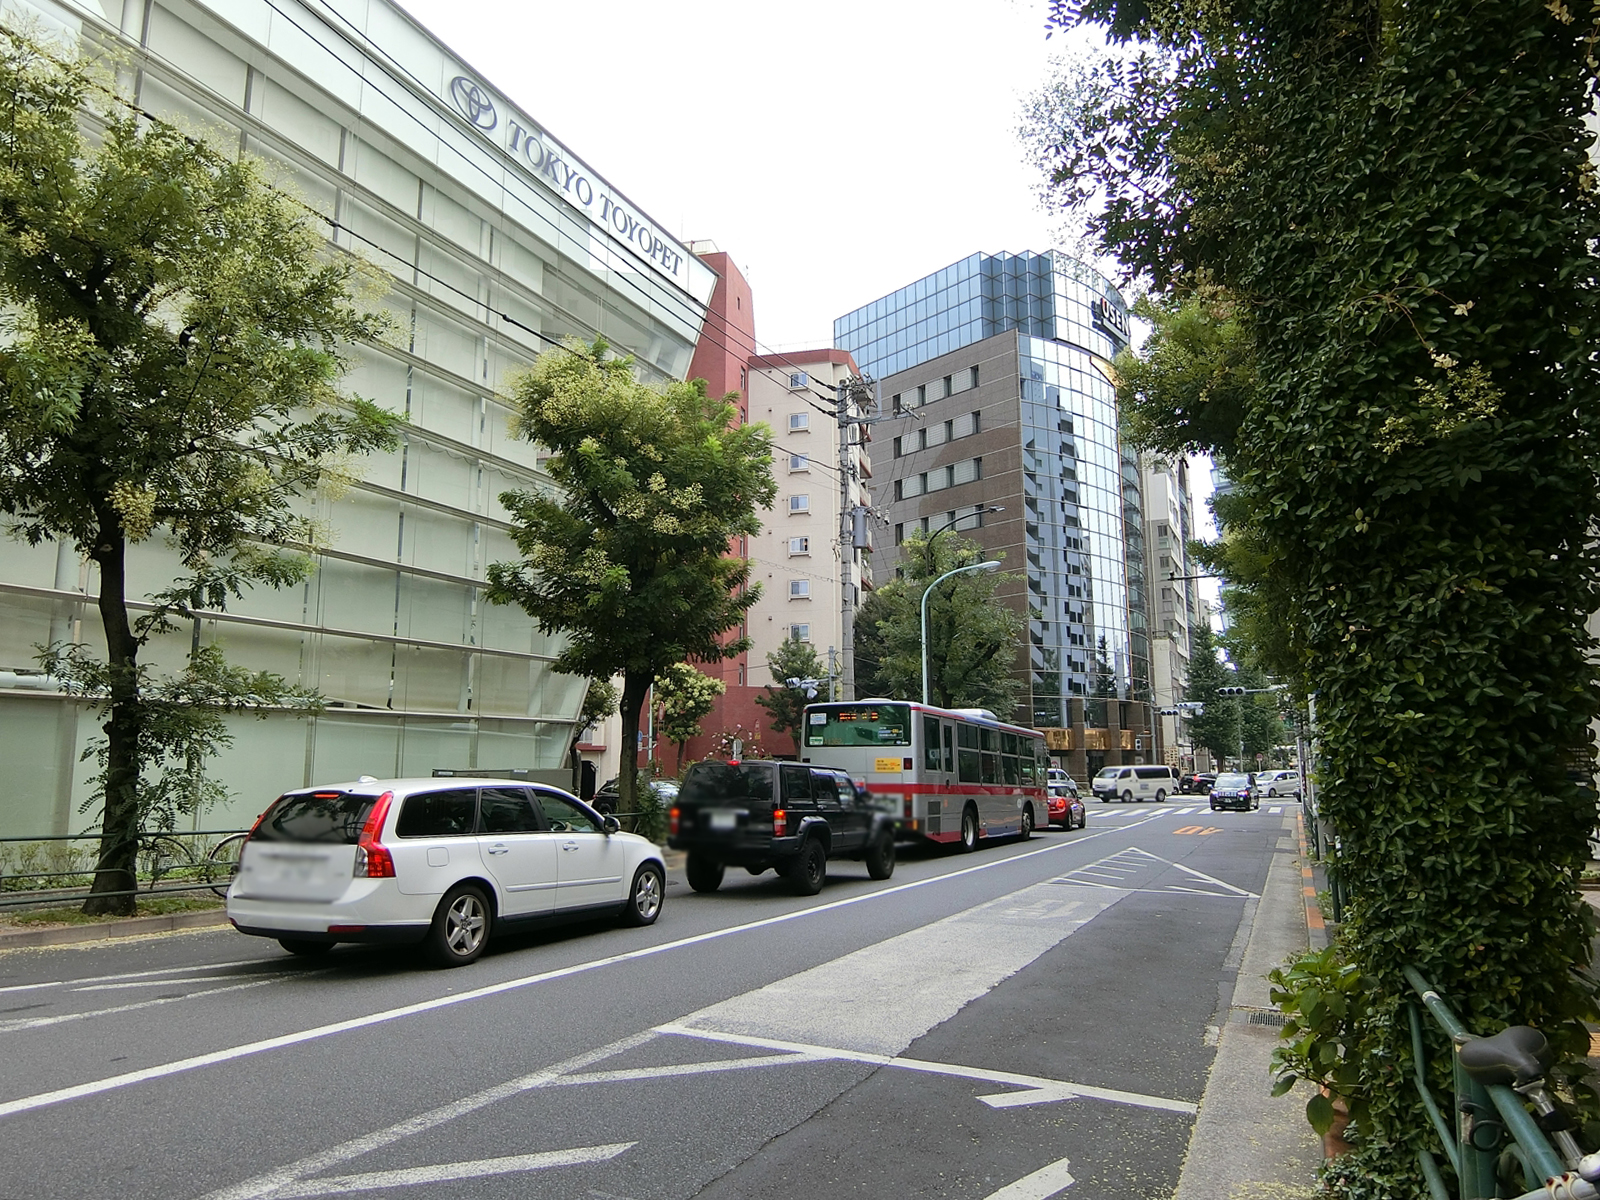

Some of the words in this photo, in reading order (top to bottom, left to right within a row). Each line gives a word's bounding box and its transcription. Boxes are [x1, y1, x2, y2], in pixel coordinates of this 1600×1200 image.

[508, 119, 593, 206] TOKYO
[599, 193, 683, 277] TOYOPET
[1100, 297, 1130, 337] USEN
